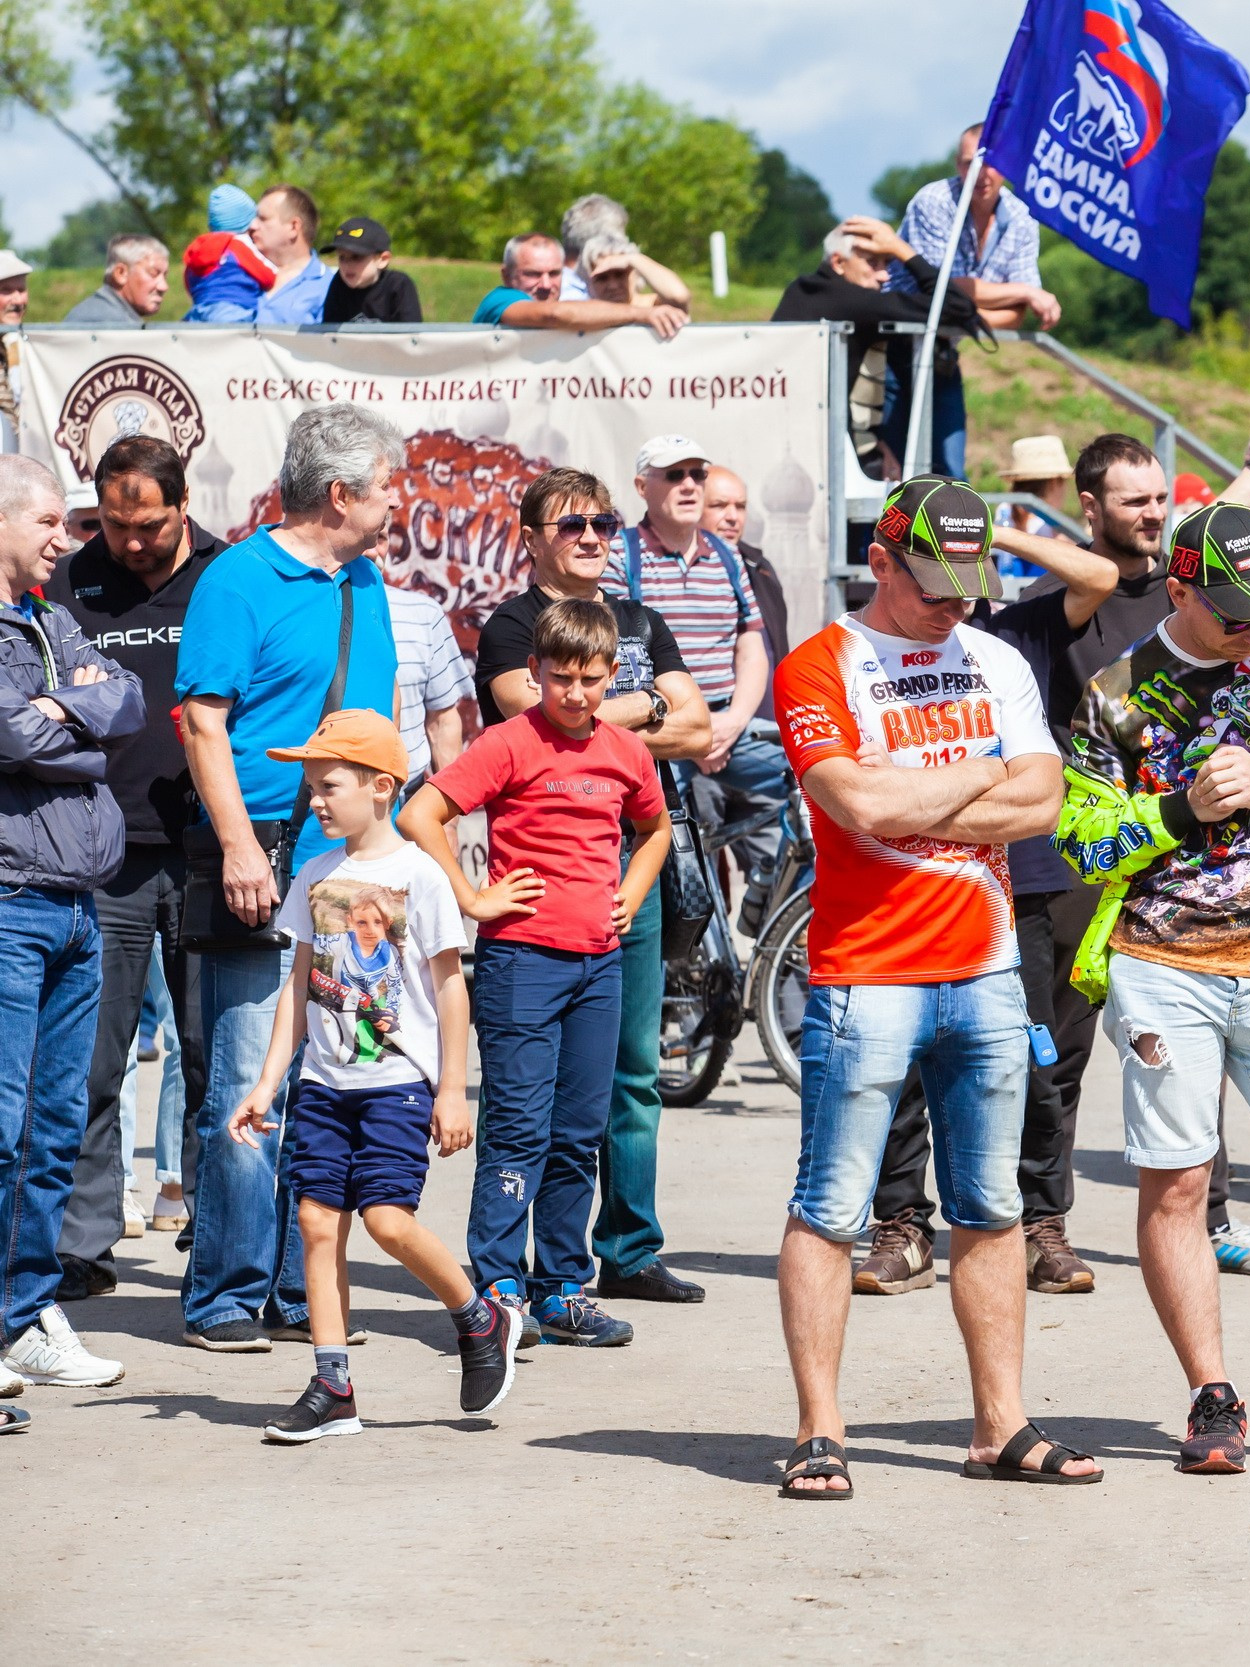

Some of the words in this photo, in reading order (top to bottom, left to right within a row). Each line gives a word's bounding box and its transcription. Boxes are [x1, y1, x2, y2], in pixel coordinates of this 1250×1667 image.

[1032, 128, 1136, 219] ЕДИНА
[1024, 163, 1142, 261] РОССИЯ
[74, 368, 139, 416] СТАРАЯ
[144, 369, 187, 417] ТУЛА
[226, 377, 384, 401] СВЕЖЕСТЬ
[401, 377, 527, 401] БЫВАЕТ
[542, 376, 653, 400] ТОЛЬКО
[669, 368, 788, 410] ПЕРВОЙ
[878, 504, 912, 543] 76
[940, 516, 985, 528] Kawasaki
[1169, 545, 1200, 579] 76
[869, 673, 941, 704] GRAND
[943, 672, 992, 694] PRIX
[789, 713, 832, 733] RUSSIA
[793, 723, 842, 747] 2012
[880, 698, 996, 753] RUSSIA
